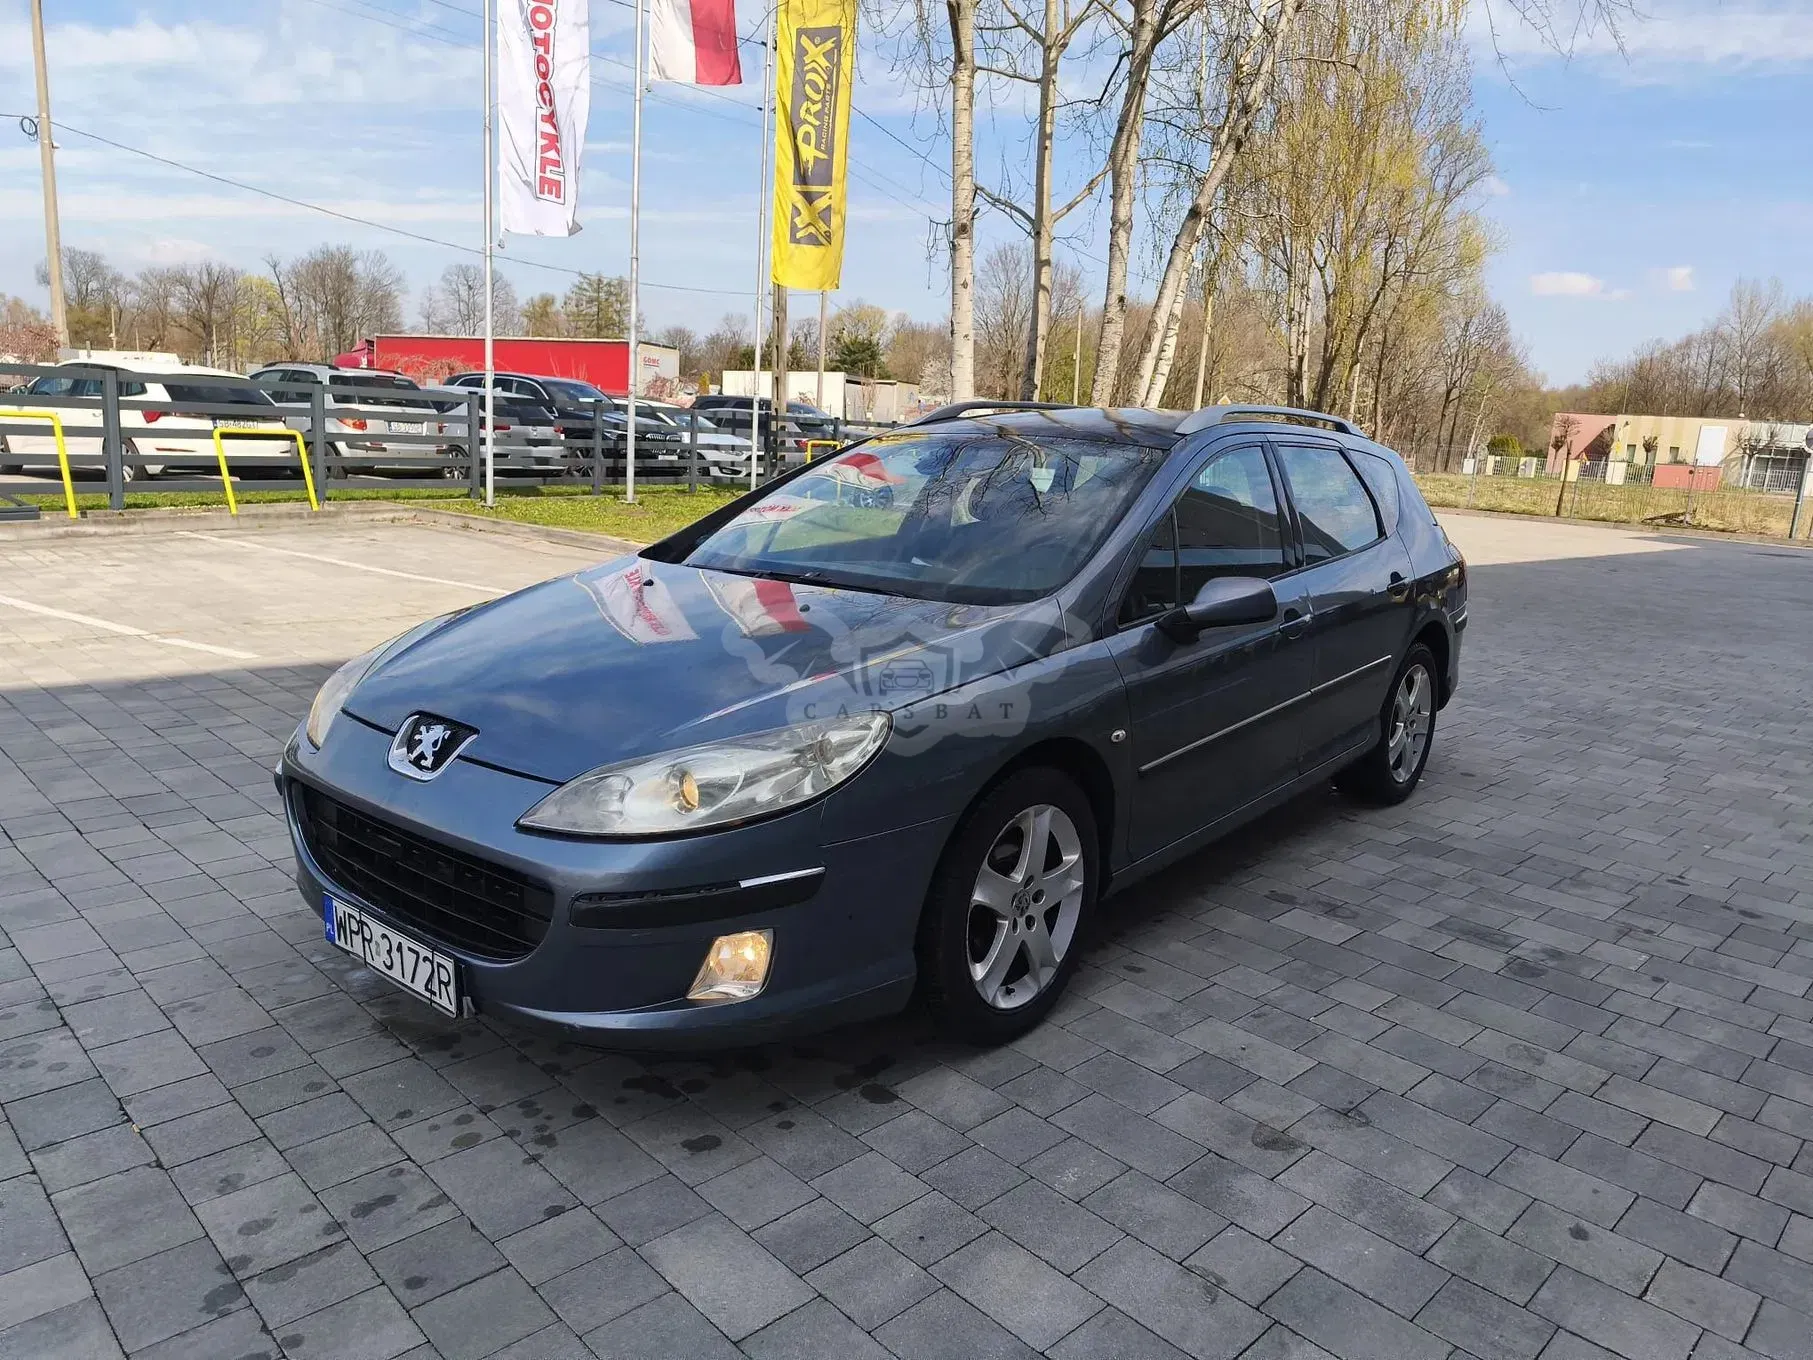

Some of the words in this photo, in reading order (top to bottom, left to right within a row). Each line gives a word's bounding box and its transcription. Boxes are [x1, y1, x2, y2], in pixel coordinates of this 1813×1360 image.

[529, 0, 561, 199] OTOCYKLE
[797, 34, 836, 177] PROX
[821, 115, 830, 151] RACING
[824, 83, 832, 114] PARTS
